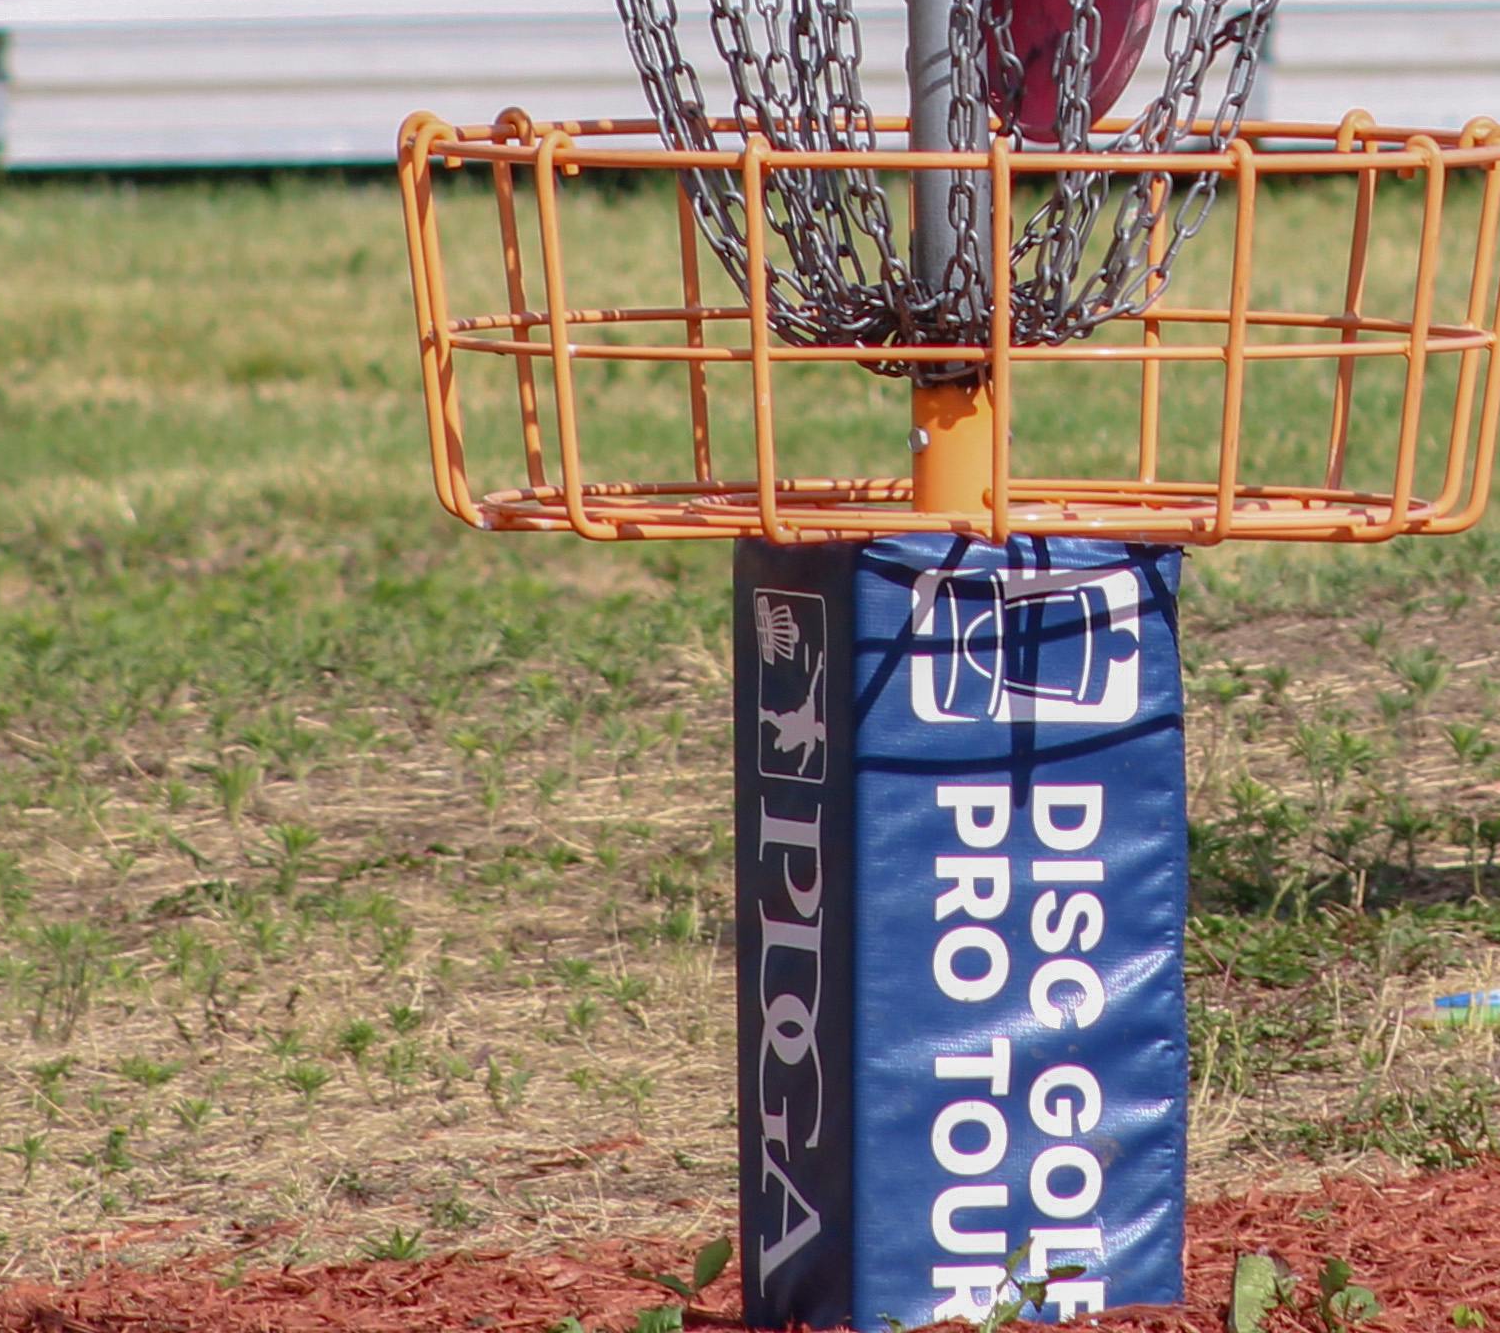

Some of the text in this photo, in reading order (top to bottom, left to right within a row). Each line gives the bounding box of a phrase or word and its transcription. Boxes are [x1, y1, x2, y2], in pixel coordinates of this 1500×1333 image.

[758, 794, 823, 1298] PDGA
[930, 783, 1012, 1323] PRO TOUR
[1028, 783, 1105, 1031] DISC
